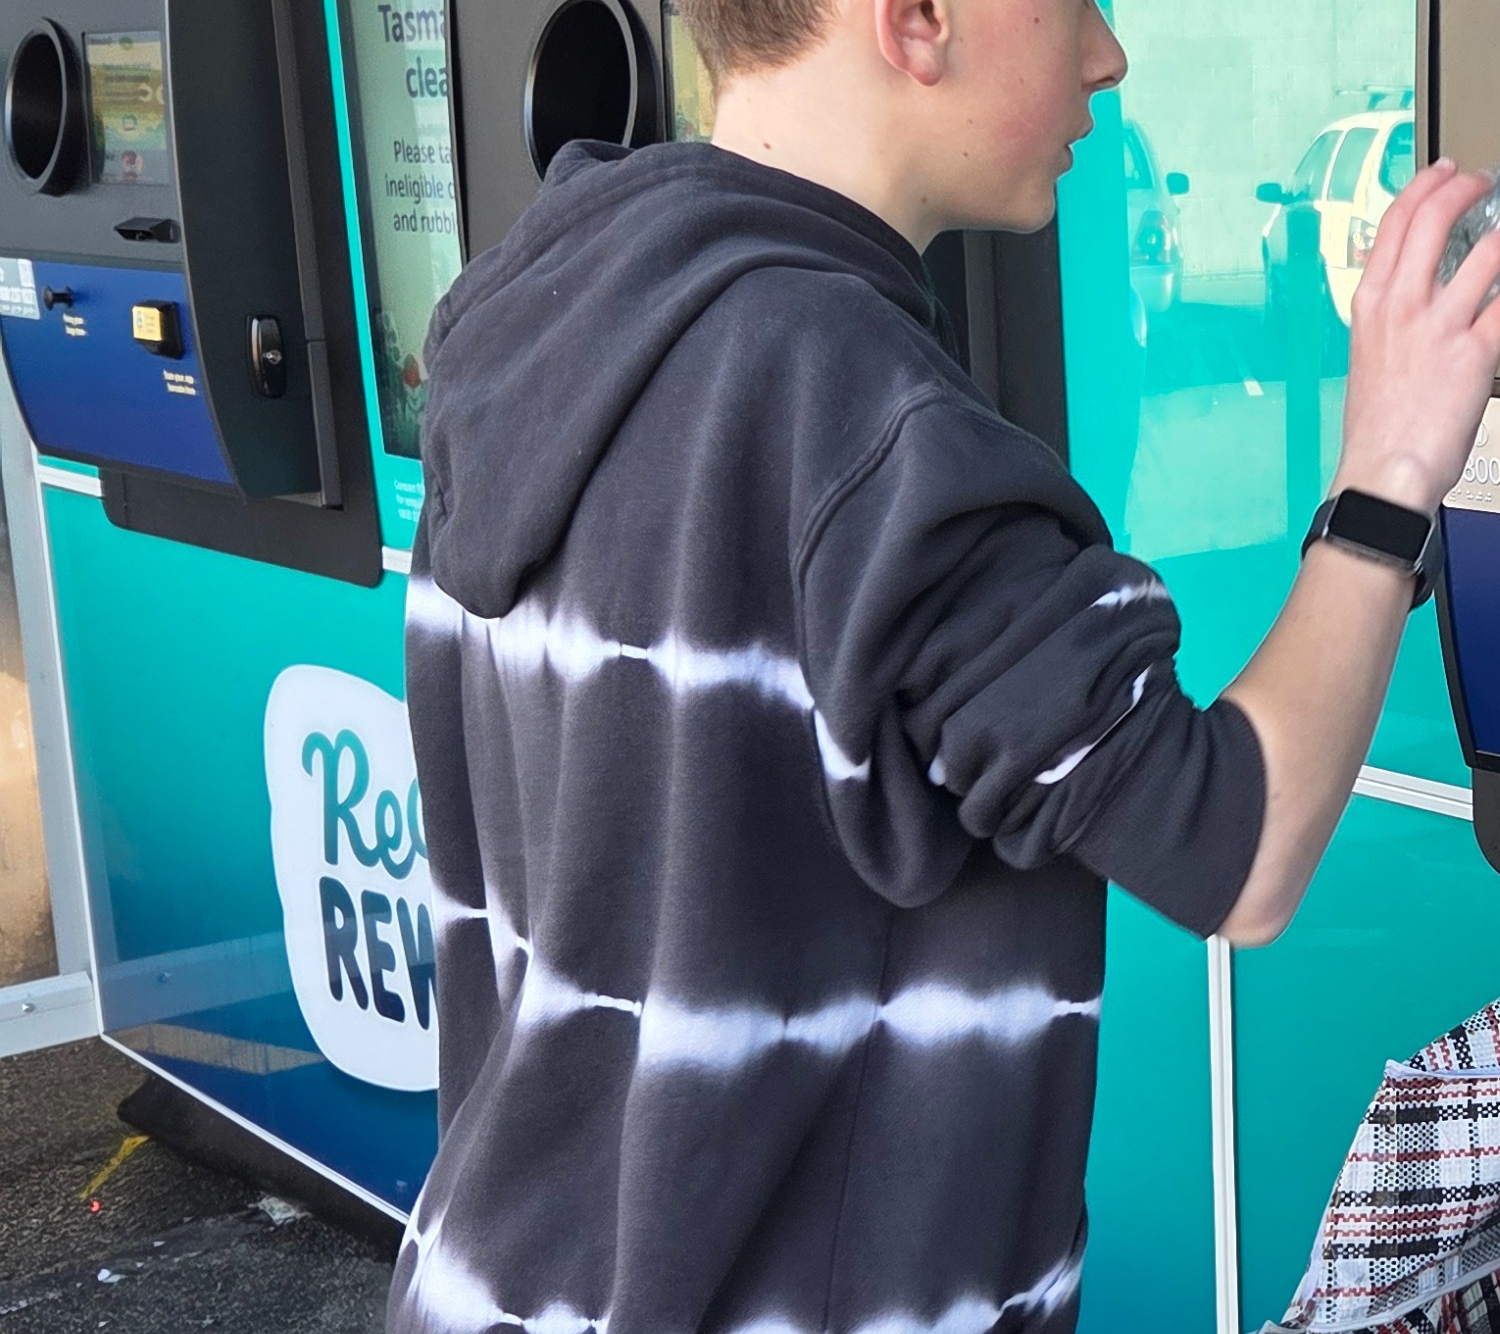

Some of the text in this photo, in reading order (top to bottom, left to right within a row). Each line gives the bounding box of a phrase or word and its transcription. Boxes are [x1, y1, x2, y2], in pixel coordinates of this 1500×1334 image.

[394, 138, 435, 163] Please
[385, 172, 443, 204] ineligible
[394, 209, 417, 232] and
